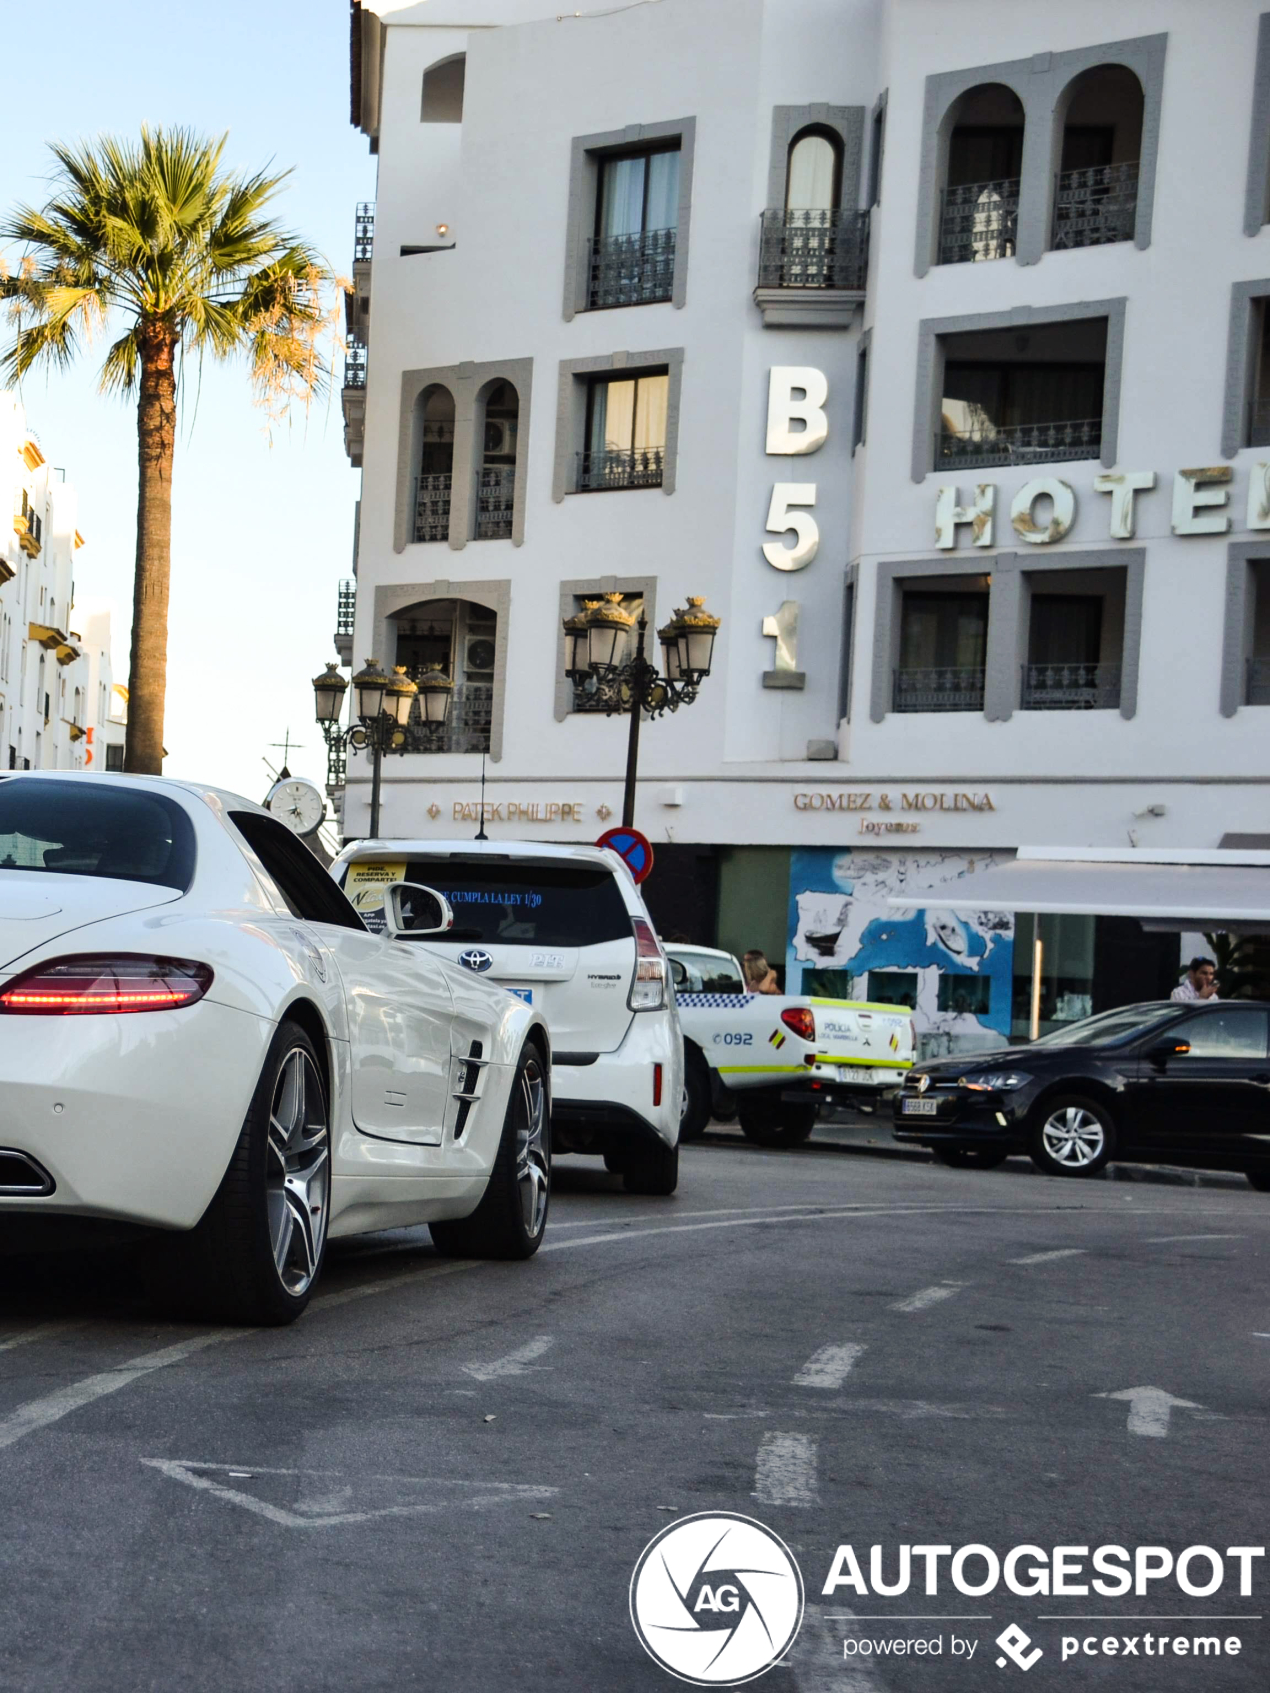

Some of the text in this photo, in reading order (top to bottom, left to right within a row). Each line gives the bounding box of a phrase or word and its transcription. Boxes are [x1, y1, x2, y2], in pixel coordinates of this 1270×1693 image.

[793, 793, 996, 811] GOMEZ & MOLINA
[453, 803, 583, 822] PATEK PHILIPPE
[451, 891, 489, 903] CUMPLA
[491, 892, 503, 903] LA
[504, 893, 522, 905] LEY
[723, 1033, 753, 1045] 092
